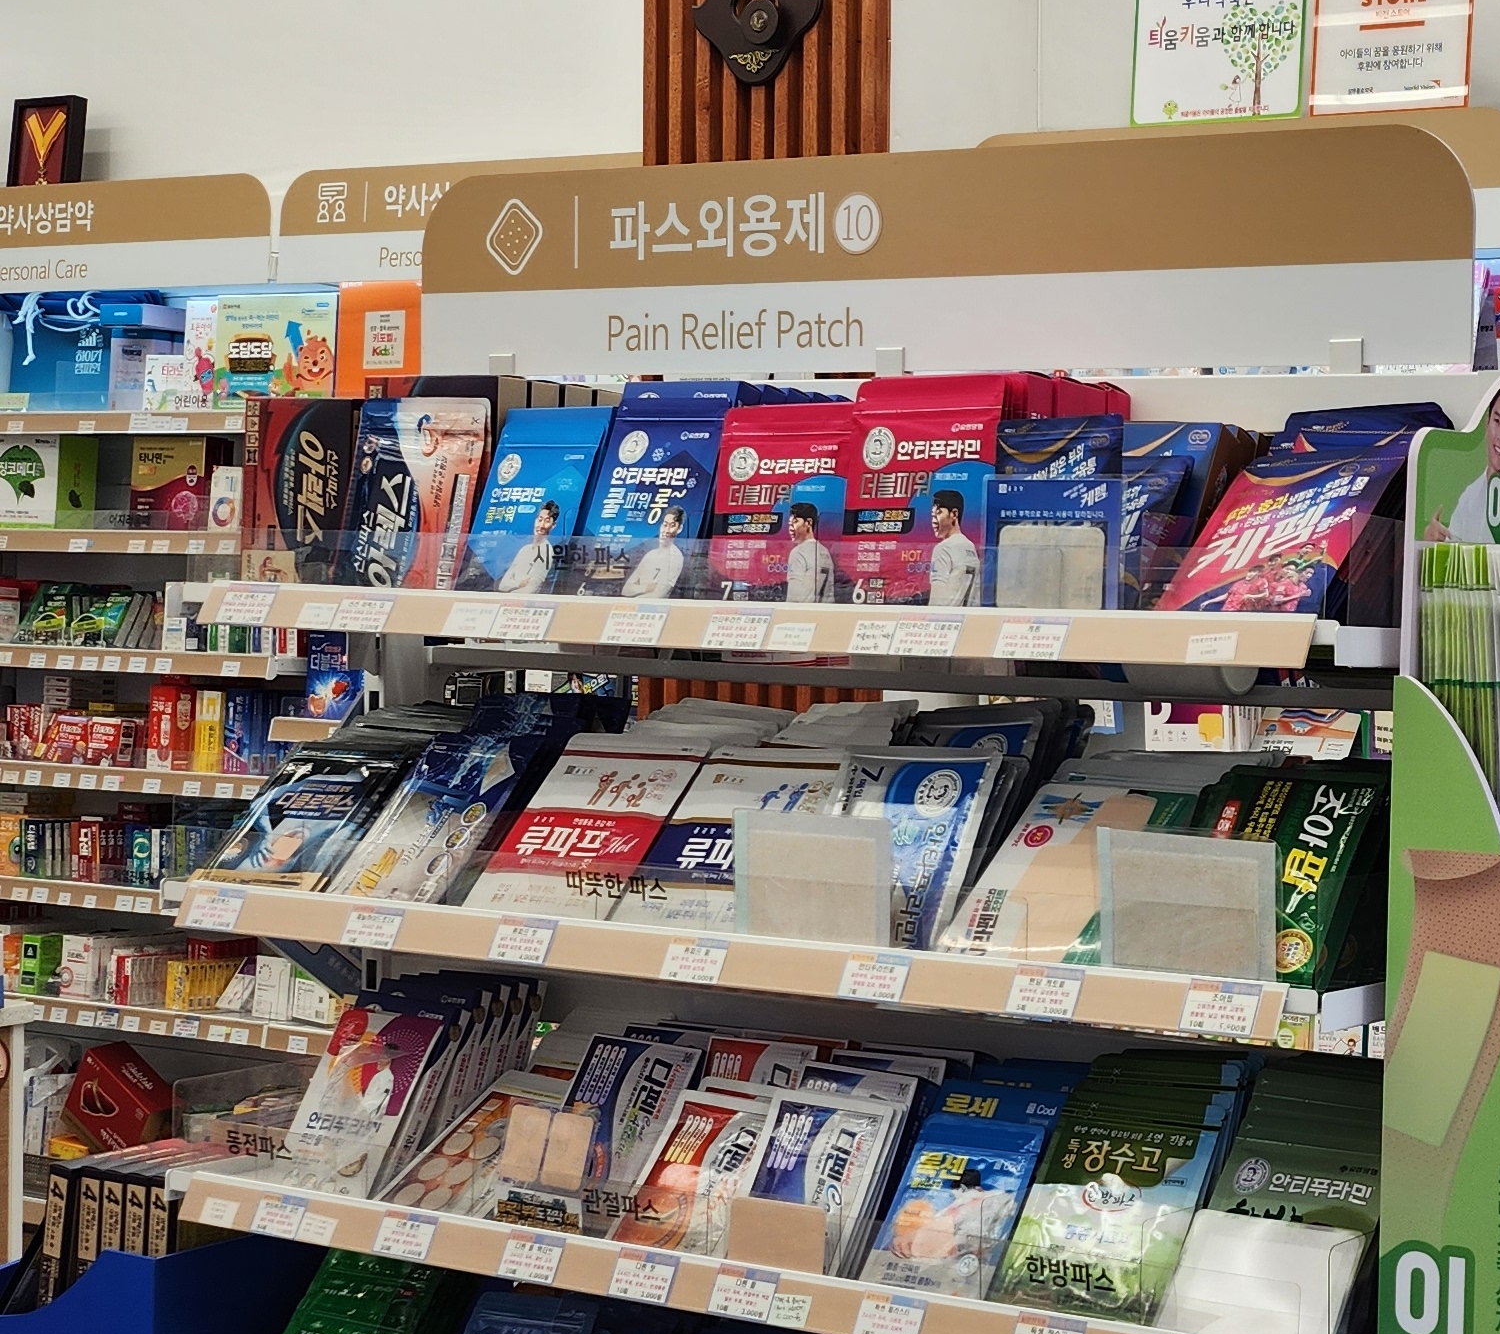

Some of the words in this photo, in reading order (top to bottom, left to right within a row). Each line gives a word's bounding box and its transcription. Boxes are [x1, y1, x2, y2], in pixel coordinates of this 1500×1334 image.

[609, 191, 826, 260] 파스외용제
[55, 259, 88, 279] Care
[607, 313, 669, 352] Pain
[681, 307, 767, 351] Relief
[777, 306, 864, 349] Patch
[758, 458, 836, 475] 안티푸라민
[897, 439, 981, 461] 안티푸라민
[610, 467, 689, 486] 안티푸라민
[860, 471, 933, 499] 더블파워
[515, 825, 609, 859] 류파프
[566, 871, 625, 901] 따뜻한
[628, 875, 667, 901] 파스
[226, 1128, 293, 1161] 동전파스
[1080, 1140, 1163, 1174] 장수고
[1268, 1170, 1373, 1207] 안티푸라민
[583, 1188, 661, 1223] 관절파스
[1025, 1253, 1117, 1294] 한방파스
